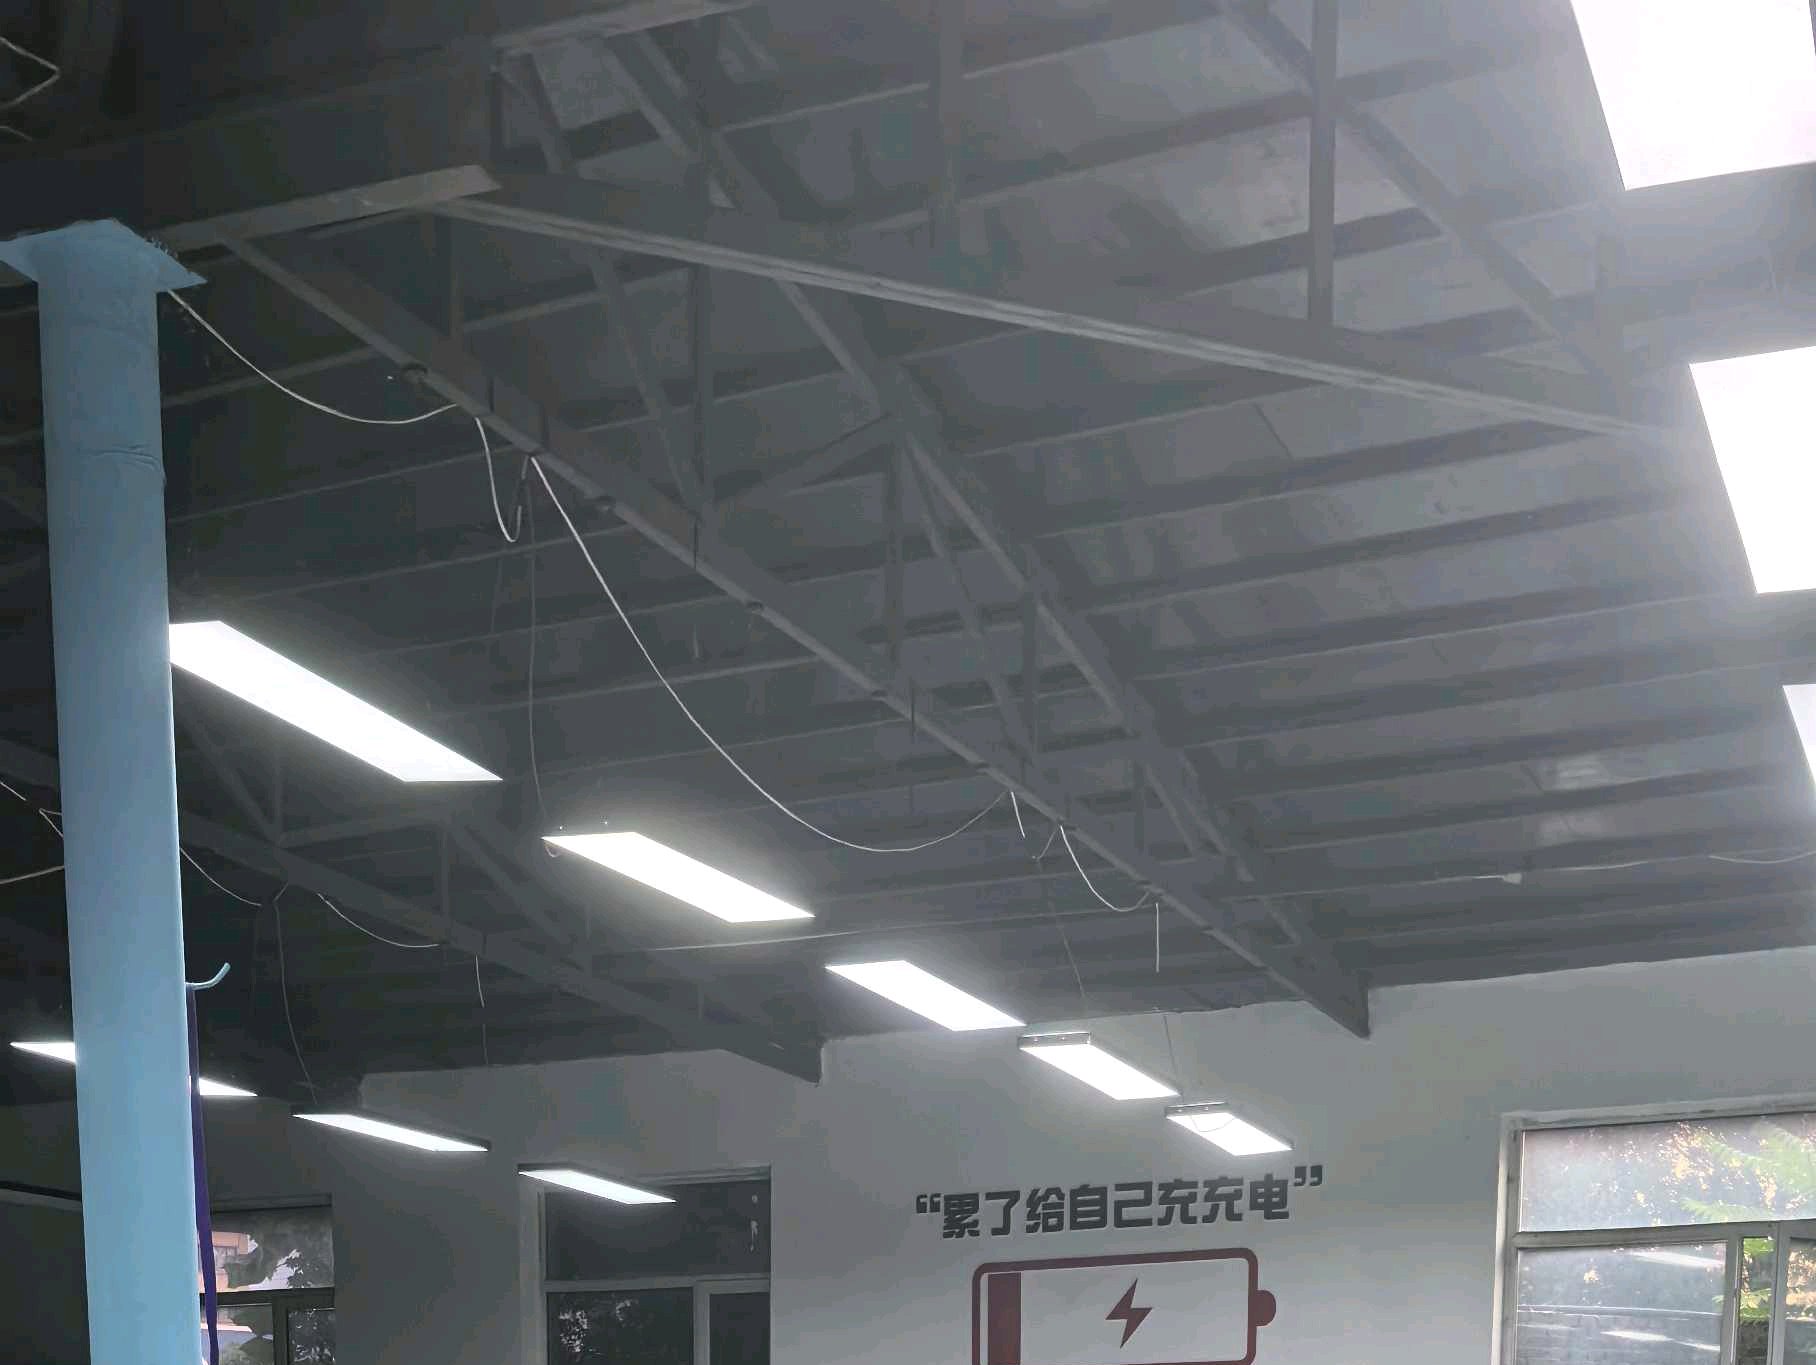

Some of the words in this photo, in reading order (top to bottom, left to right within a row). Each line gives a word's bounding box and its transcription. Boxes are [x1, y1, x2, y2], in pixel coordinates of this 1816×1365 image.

[916, 1165, 1323, 1238] “累了给自己充充电”
